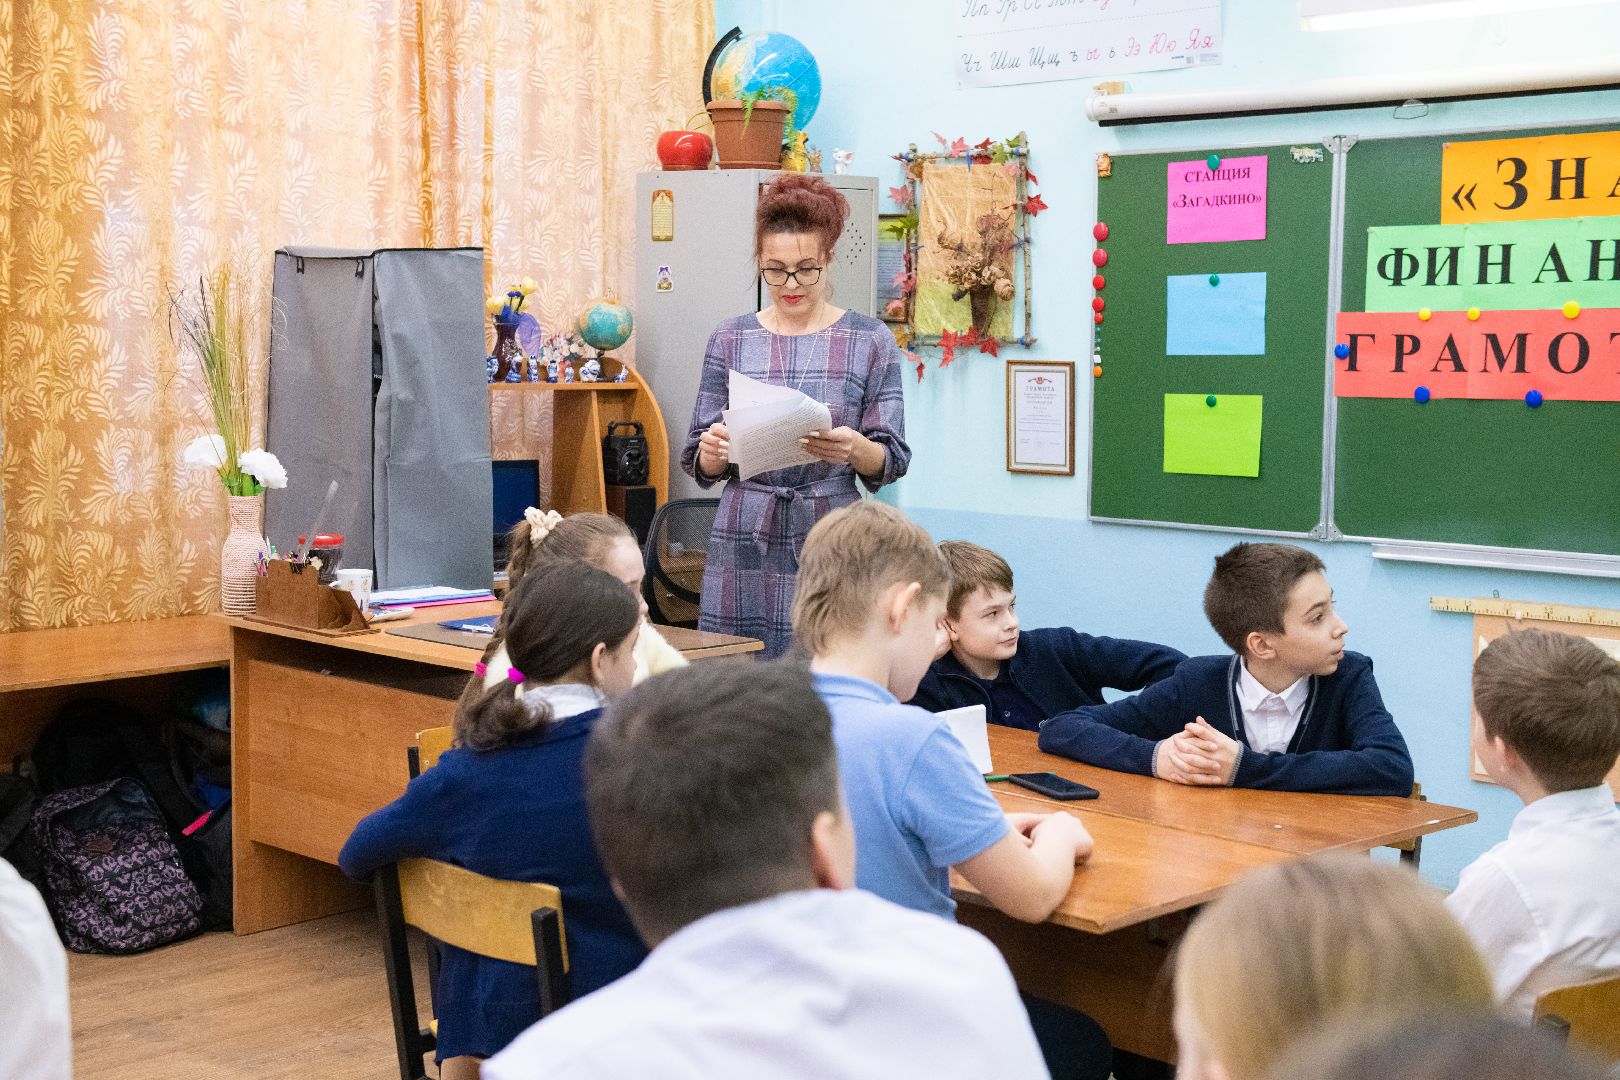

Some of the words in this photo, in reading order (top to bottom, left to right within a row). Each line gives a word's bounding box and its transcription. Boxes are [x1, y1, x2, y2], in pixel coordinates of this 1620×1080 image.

[990, 50, 1020, 70] Шш
[1029, 46, 1060, 69] Щщ
[1149, 32, 1177, 54] Юю
[1185, 28, 1214, 50] Яя
[1184, 167, 1251, 183] СТАНЦИЯ
[1376, 239, 1620, 287] ФИНАН
